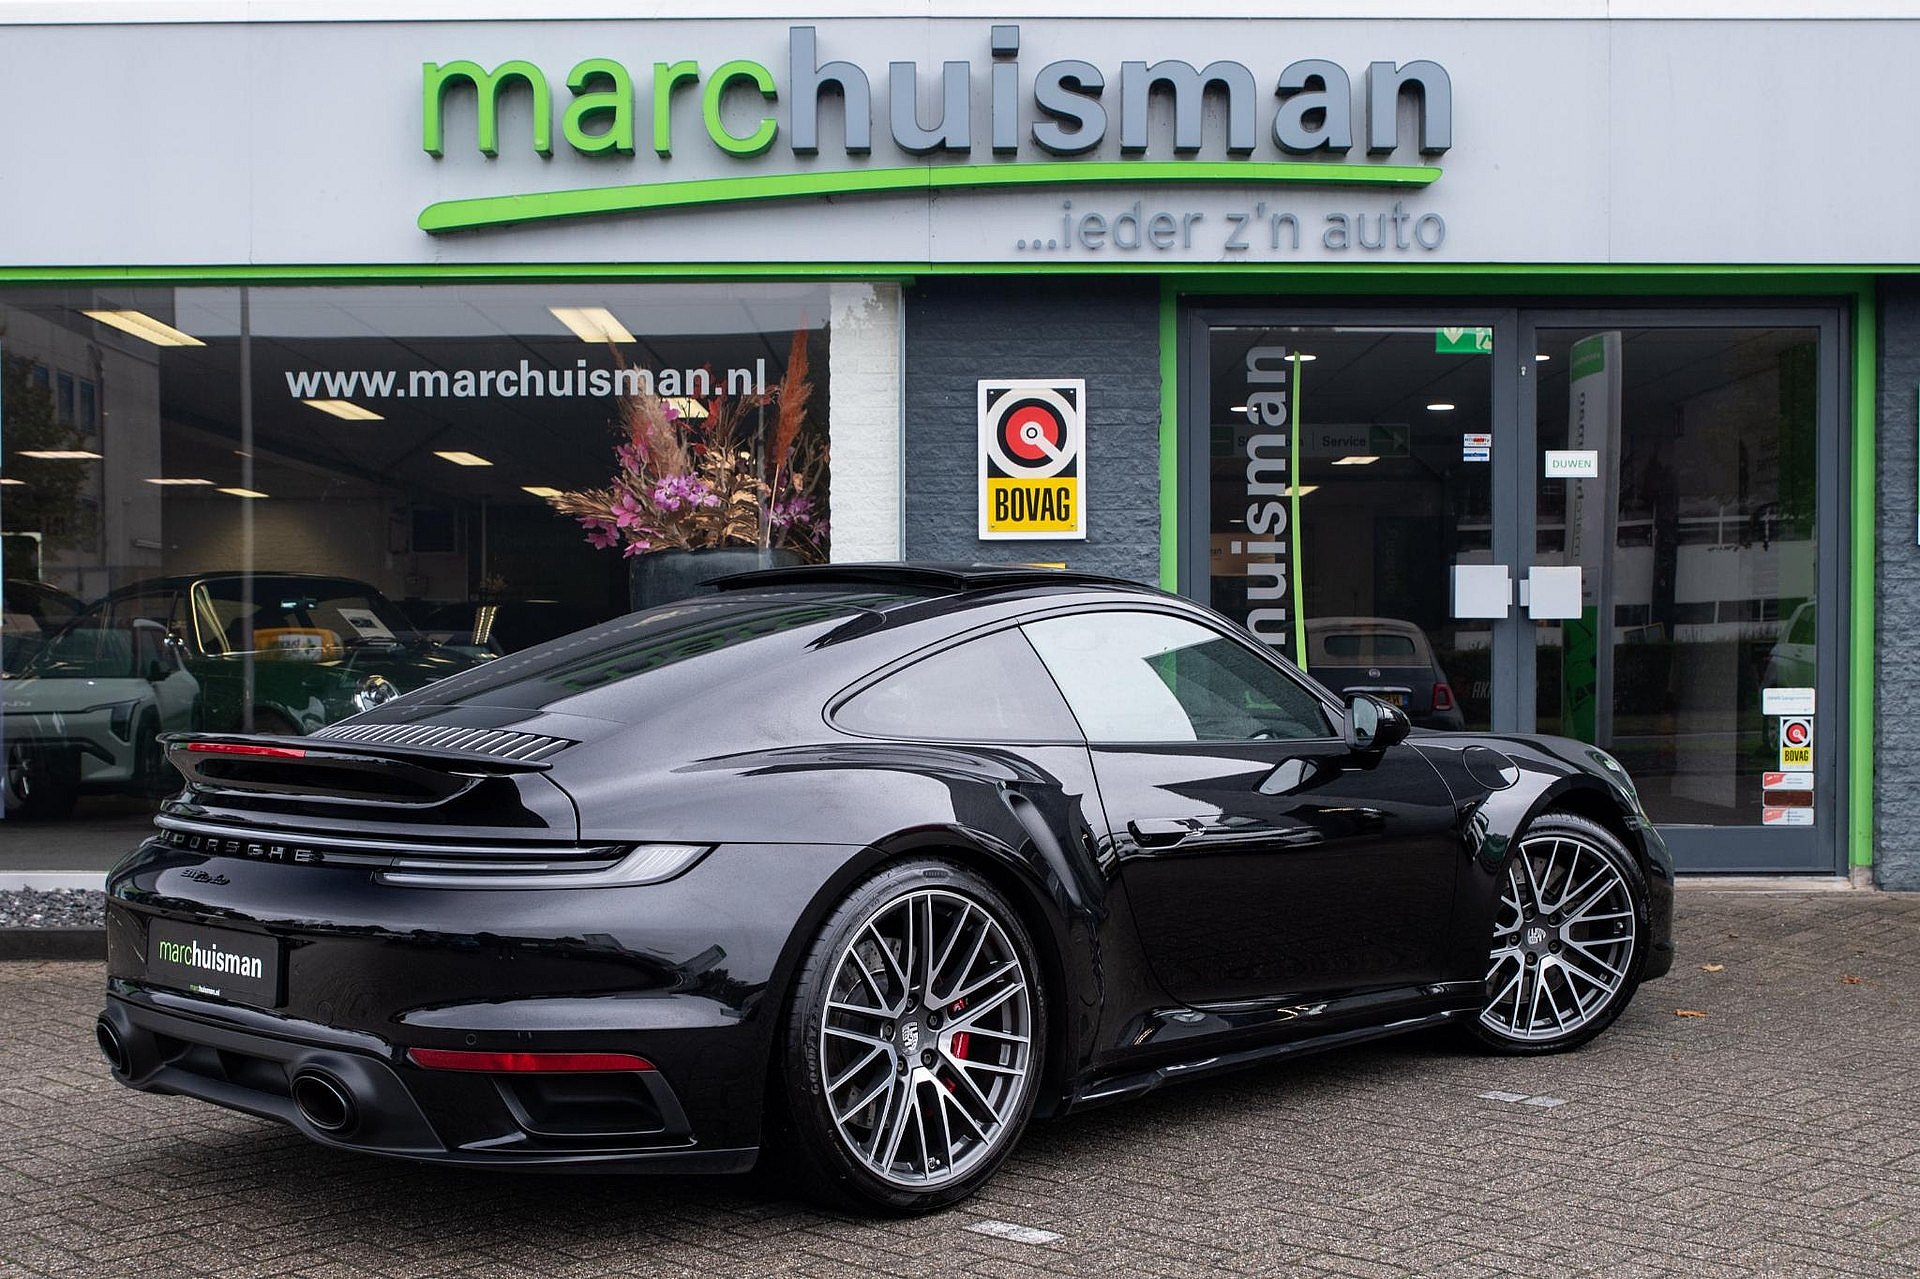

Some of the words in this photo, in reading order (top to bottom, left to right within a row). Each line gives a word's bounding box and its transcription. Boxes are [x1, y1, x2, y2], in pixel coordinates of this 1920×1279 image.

[421, 25, 1453, 158] marchuisman
[1016, 200, 1204, 250] ...ieder
[1224, 202, 1299, 250] z'n
[1322, 201, 1447, 250] auto
[285, 358, 766, 398] www.marchuisman.nl
[1322, 436, 1367, 448] Service
[1552, 459, 1592, 469] DUWEN
[995, 486, 1070, 522] BOVAG
[1784, 750, 1809, 762] BOVAG
[170, 831, 314, 863] PORSCHE
[159, 940, 262, 979] marchuisman
